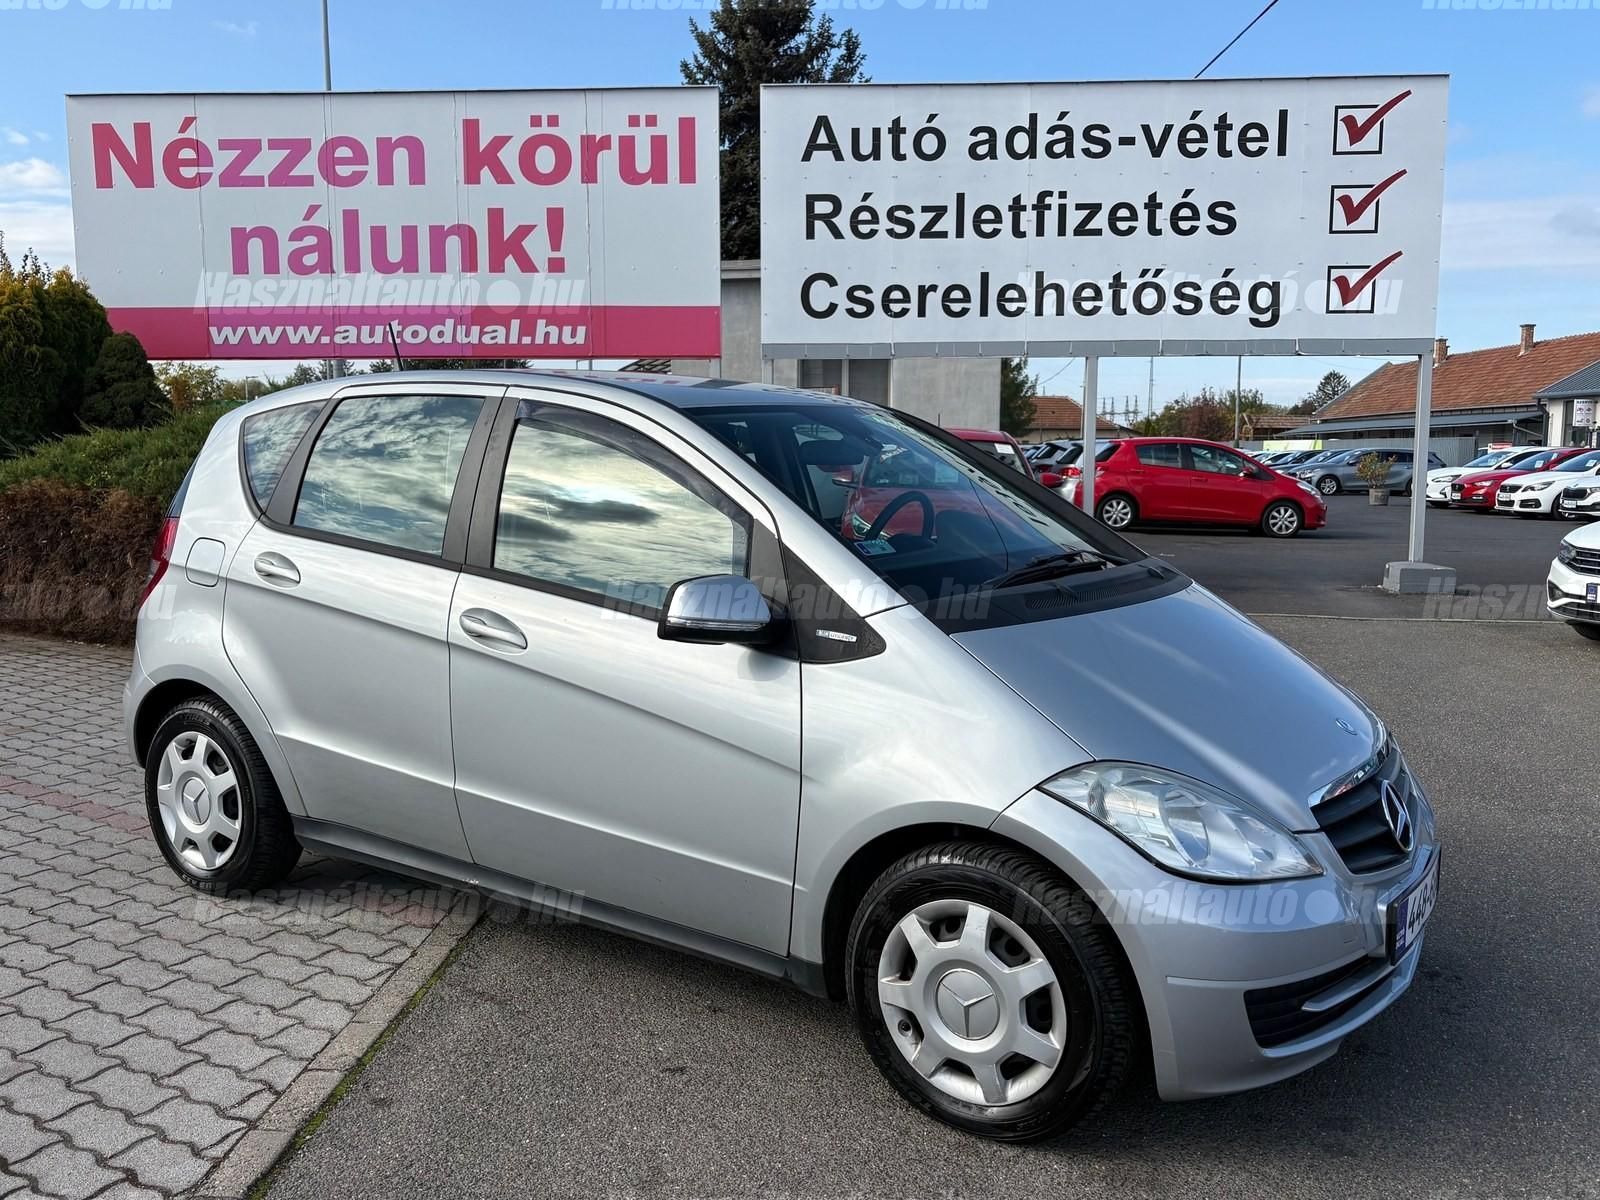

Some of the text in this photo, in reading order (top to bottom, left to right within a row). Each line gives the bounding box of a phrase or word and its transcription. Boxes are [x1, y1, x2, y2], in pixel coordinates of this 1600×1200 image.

[92, 114, 697, 189] Nézzen körül
[800, 109, 1289, 162] Autó adás-vétel
[230, 204, 566, 275] nálunk!
[804, 189, 1238, 241] Részletfizetés
[800, 268, 1282, 328] Cserelehetőség
[208, 318, 588, 346] www.autodual.hu
